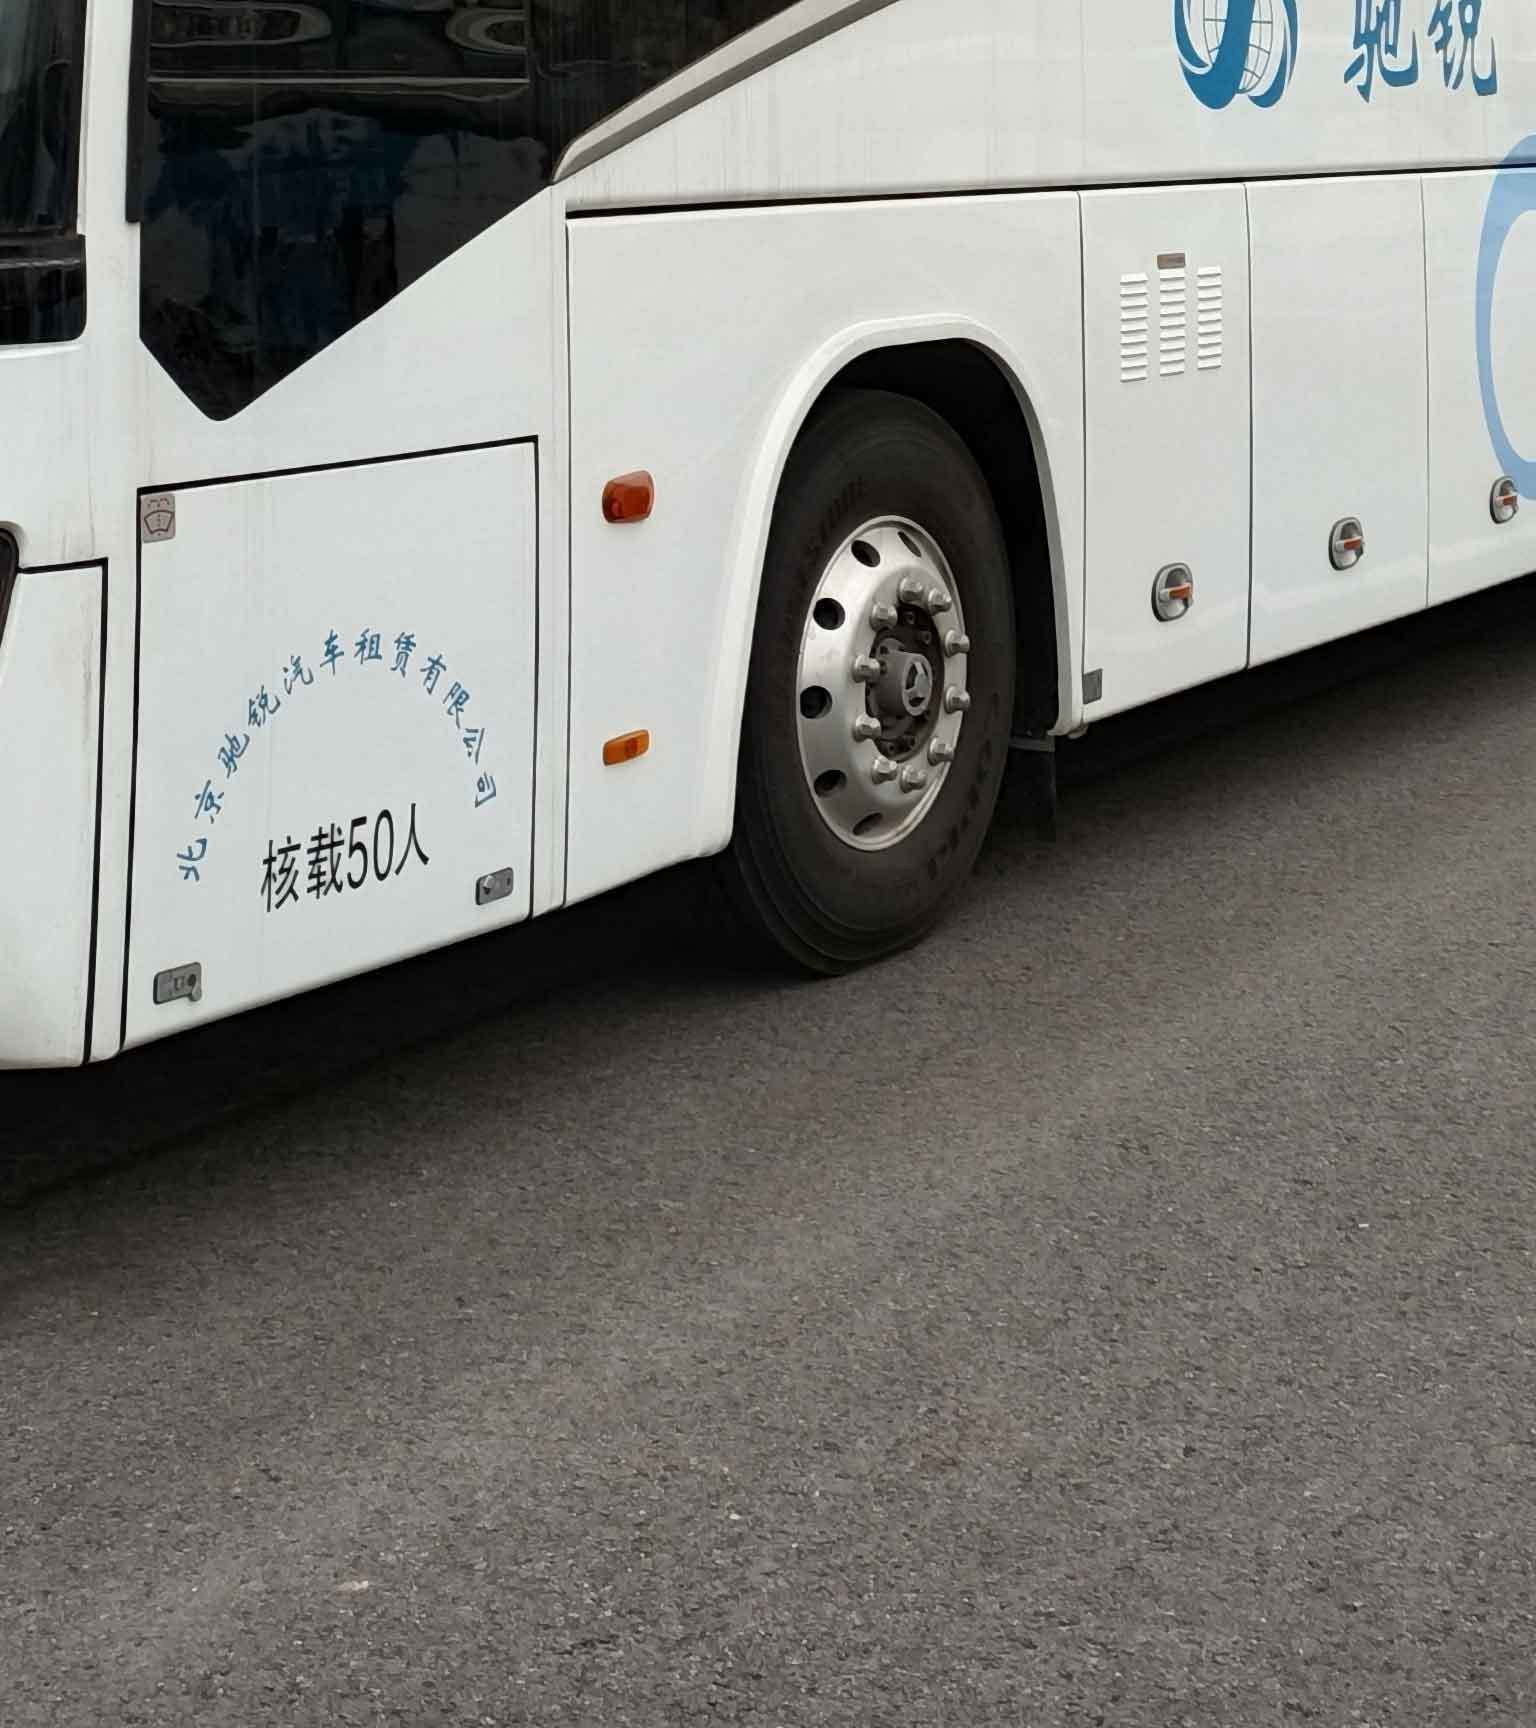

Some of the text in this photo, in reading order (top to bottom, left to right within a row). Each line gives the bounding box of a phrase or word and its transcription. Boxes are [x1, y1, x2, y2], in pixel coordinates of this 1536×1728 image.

[176, 628, 497, 882] 北京驰锐汽车租赁有限公司
[260, 802, 430, 913] 核载50人
